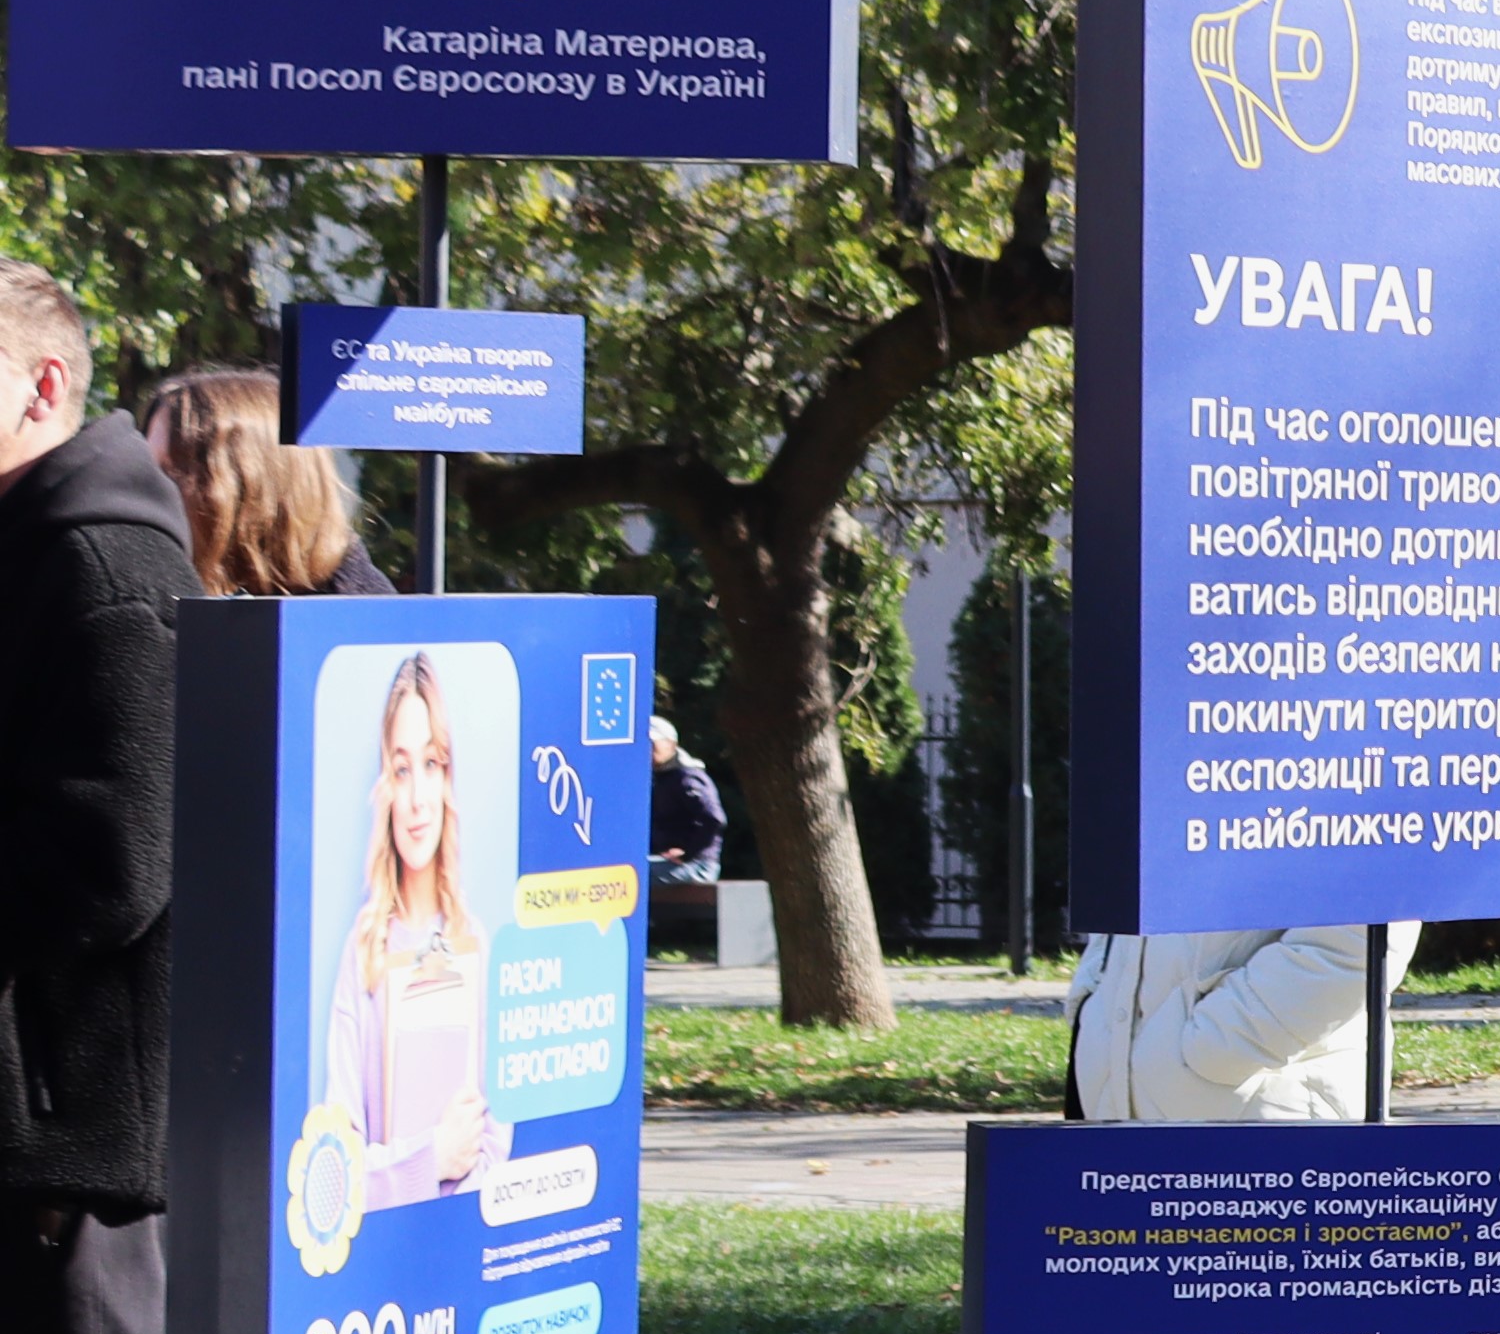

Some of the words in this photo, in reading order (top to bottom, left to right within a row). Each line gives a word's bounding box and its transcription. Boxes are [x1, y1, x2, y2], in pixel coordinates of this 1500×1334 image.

[383, 25, 545, 61] Катаріна
[555, 28, 767, 65] Матернова,
[182, 60, 259, 90] пані
[269, 62, 383, 92] Посол
[392, 64, 597, 101] Євросоюзу
[606, 73, 627, 96] в
[634, 68, 766, 103] Україні
[1407, 89, 1493, 122] правил,
[1189, 253, 1433, 337] УВАГА!
[331, 338, 362, 360] ЄС
[365, 343, 391, 362] та
[391, 339, 472, 368] Україна
[473, 346, 554, 371] творять
[393, 401, 492, 429] майбутнє
[1191, 396, 1255, 446] Під
[1265, 407, 1330, 442] час
[1186, 819, 1208, 852] в
[1218, 805, 1424, 851] найближче
[499, 957, 562, 997] РАЗОМ
[498, 993, 616, 1043] НАВЧАЄМОСЯ
[505, 1038, 610, 1089] ЗРОСТАЄМО
[1081, 1171, 1294, 1195] Представництво
[1300, 1166, 1492, 1192] Європейського
[1145, 1227, 1296, 1245] навчаємося
[1304, 1222, 1310, 1242] і
